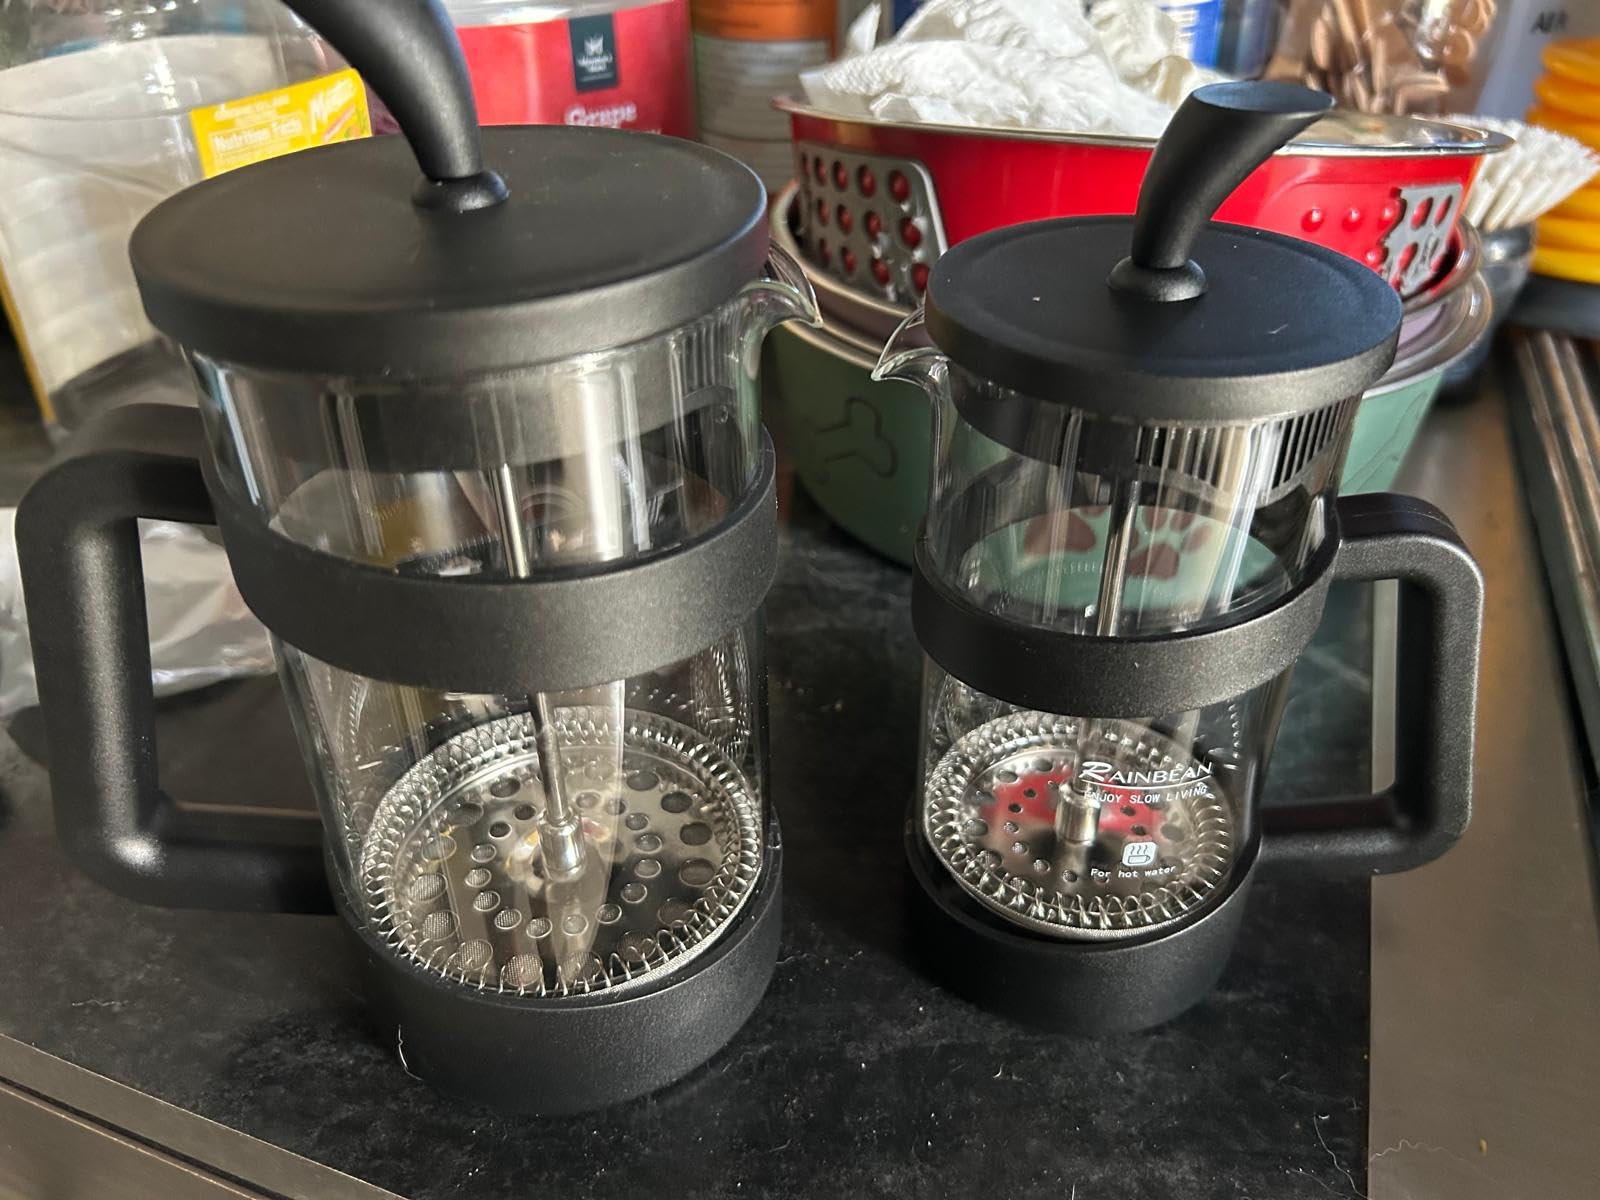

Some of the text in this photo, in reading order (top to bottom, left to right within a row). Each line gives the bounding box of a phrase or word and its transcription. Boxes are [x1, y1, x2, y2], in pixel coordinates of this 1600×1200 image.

[1078, 761, 1212, 784] RAINBEAN
[1083, 785, 1208, 804] ENJOY SLOW LIVING
[1090, 865, 1176, 878] For hot water
